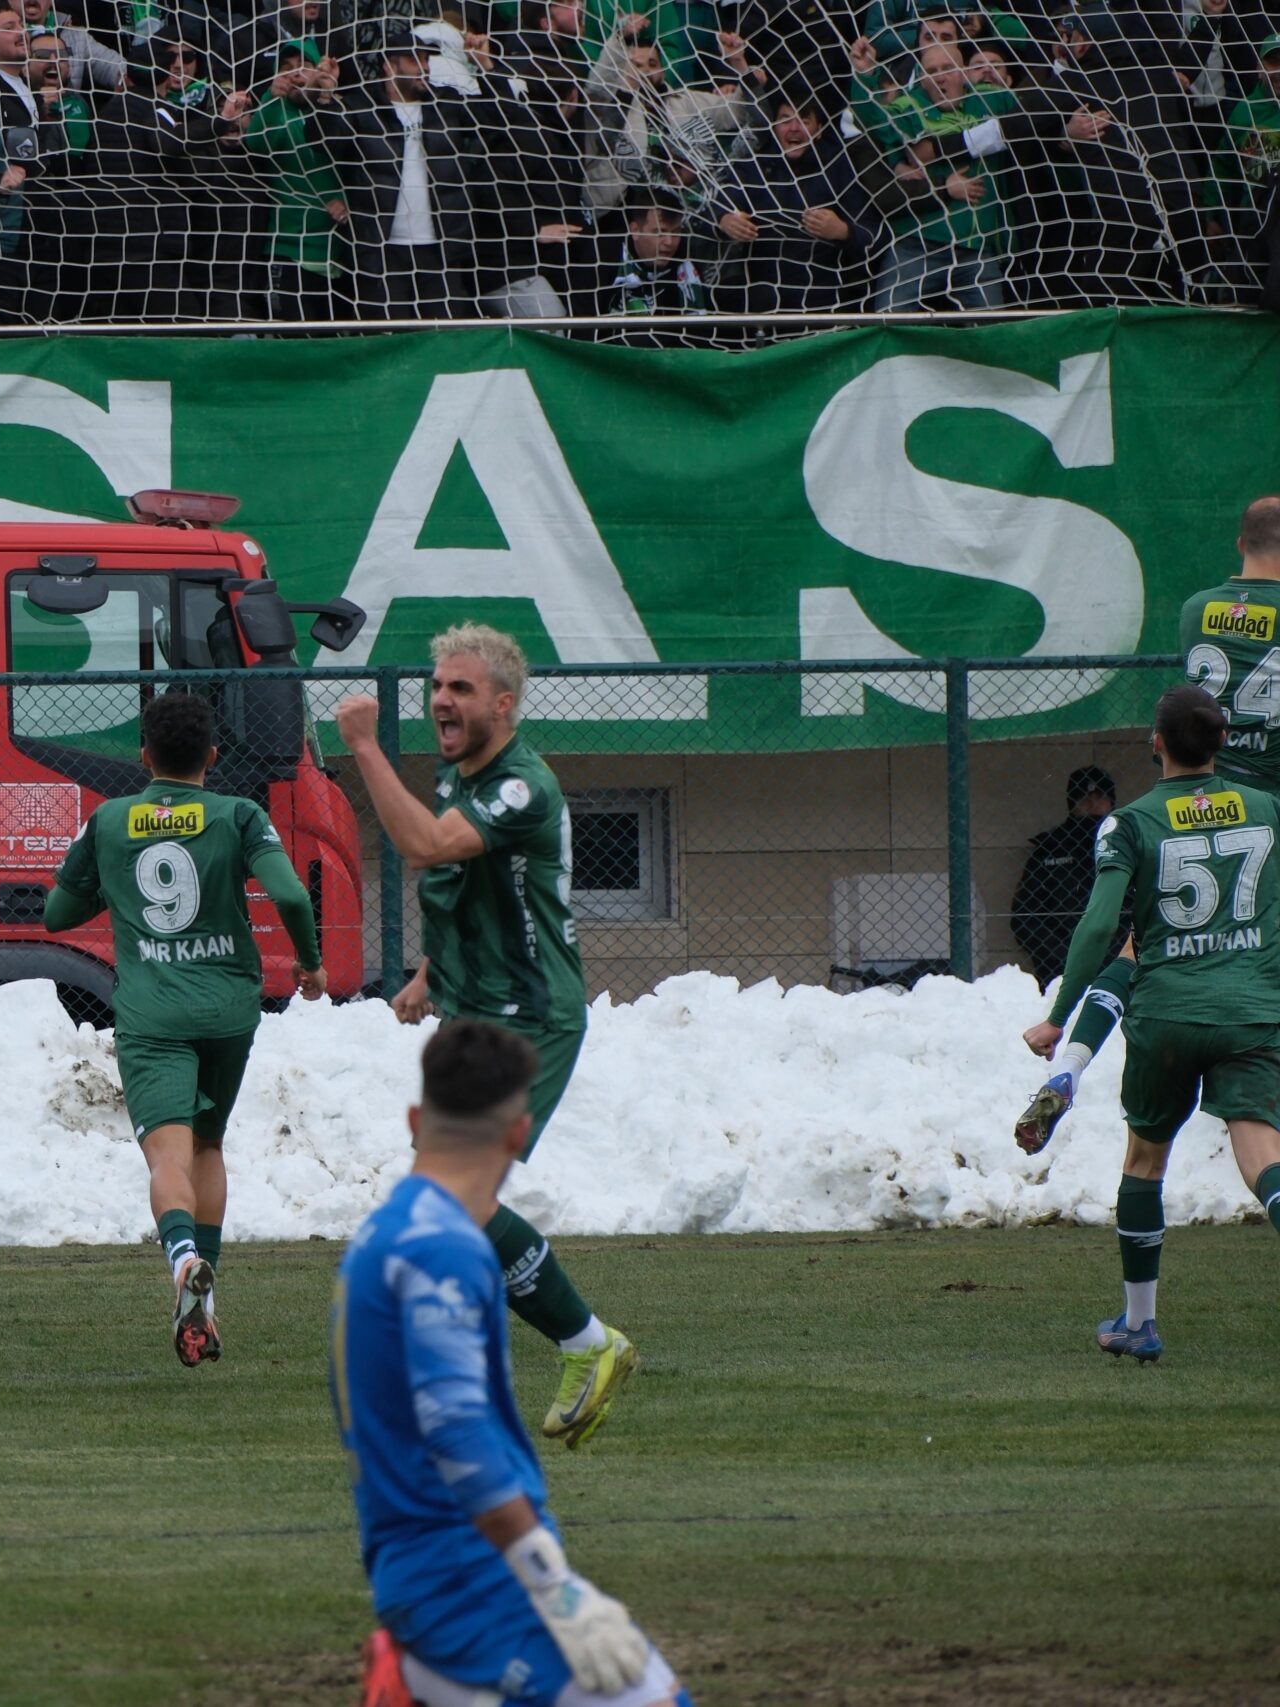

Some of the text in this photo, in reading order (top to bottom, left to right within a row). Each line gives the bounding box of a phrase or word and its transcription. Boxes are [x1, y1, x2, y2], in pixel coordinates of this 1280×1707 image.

[1185, 643, 1280, 729] 24
[134, 809, 197, 832] uludağ
[1175, 800, 1240, 825] uludağ
[136, 841, 200, 933] 9
[1158, 826, 1274, 930] 57
[175, 934, 235, 962] KAAN
